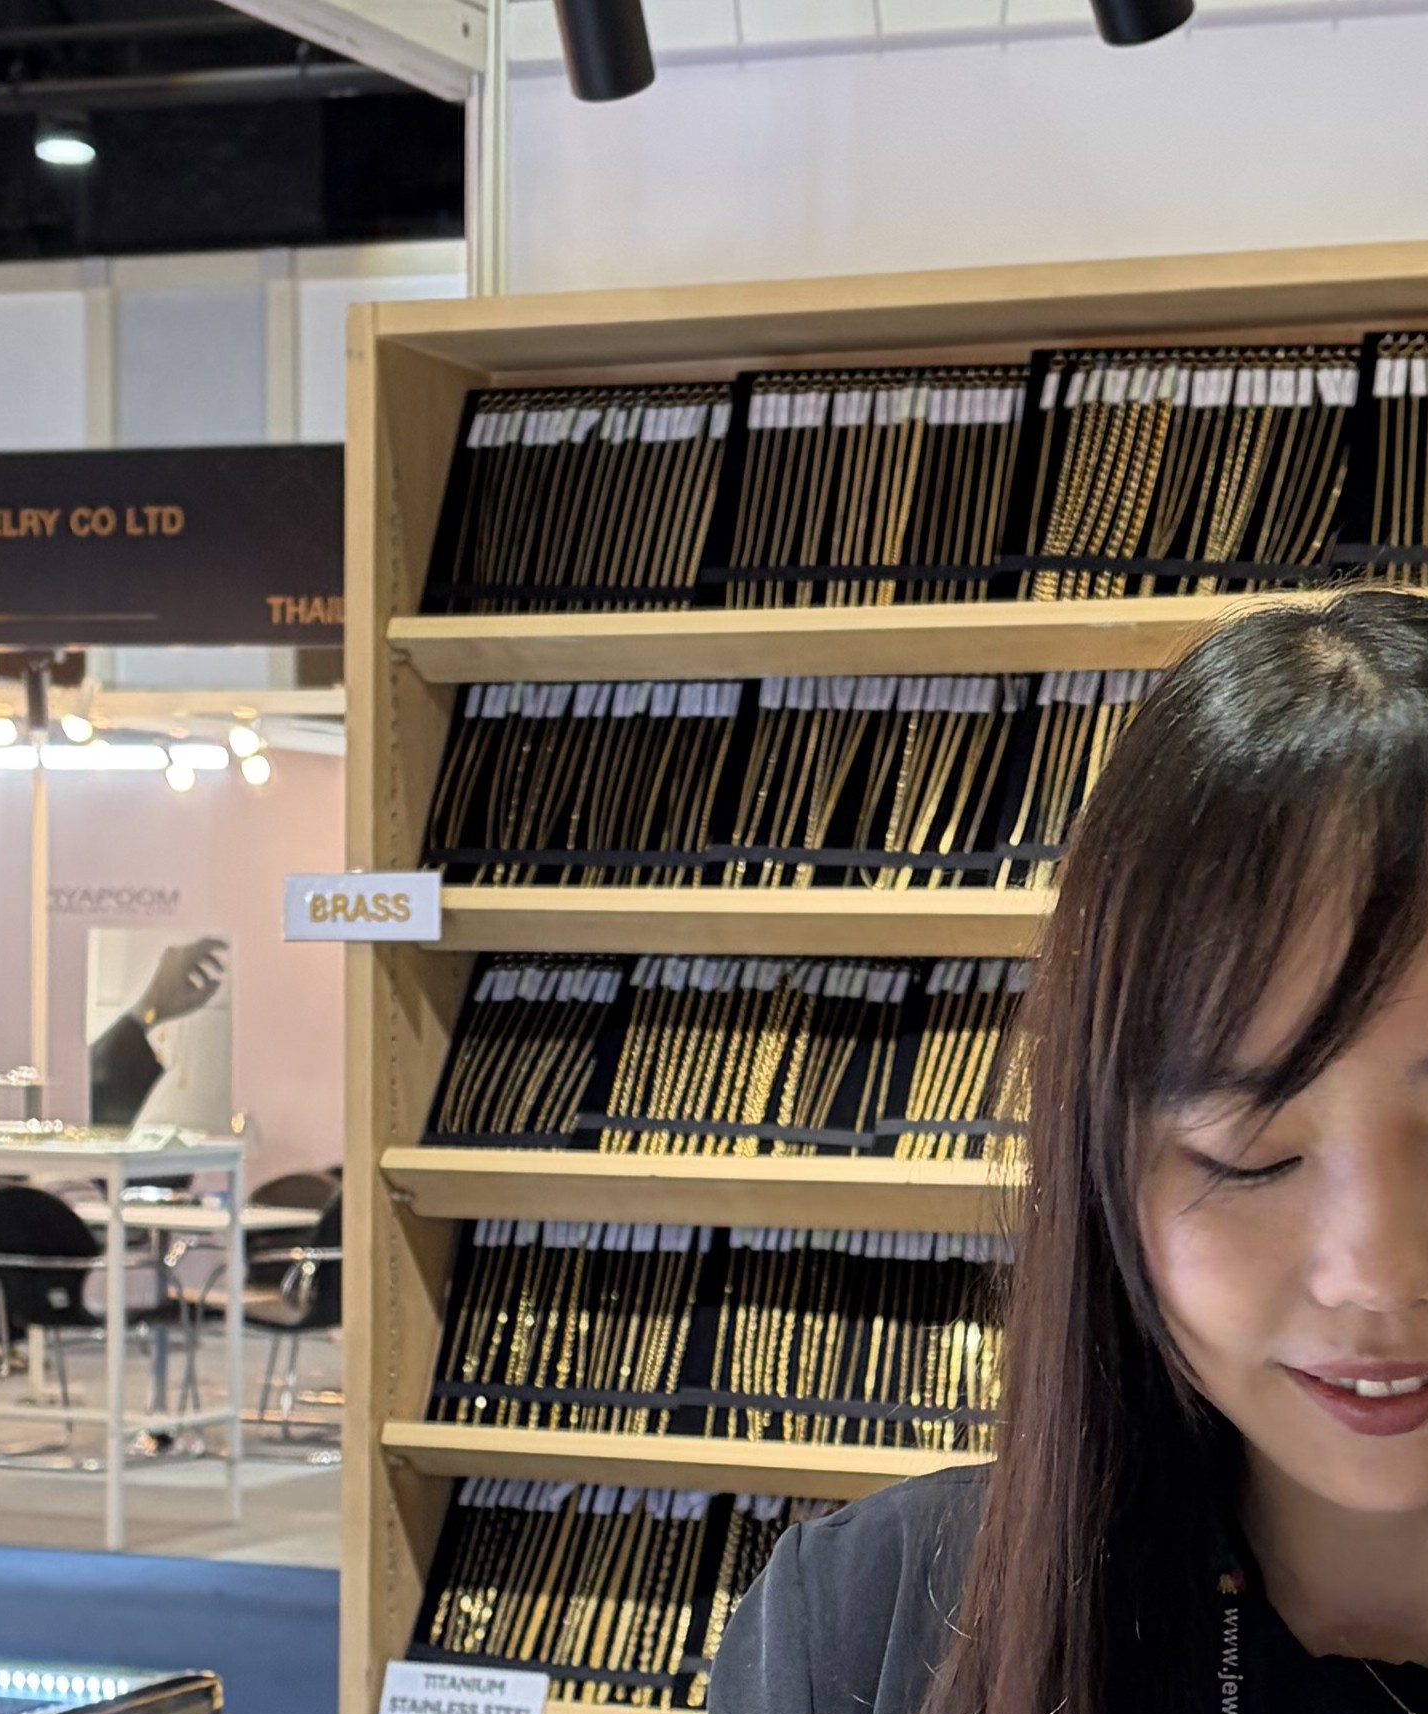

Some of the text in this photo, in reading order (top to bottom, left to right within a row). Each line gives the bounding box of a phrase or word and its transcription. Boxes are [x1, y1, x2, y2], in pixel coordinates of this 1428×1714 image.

[70, 507, 115, 538] CO
[125, 505, 185, 537] LTD
[308, 892, 411, 923] BRASS
[423, 1673, 507, 1696] TITANIUM
